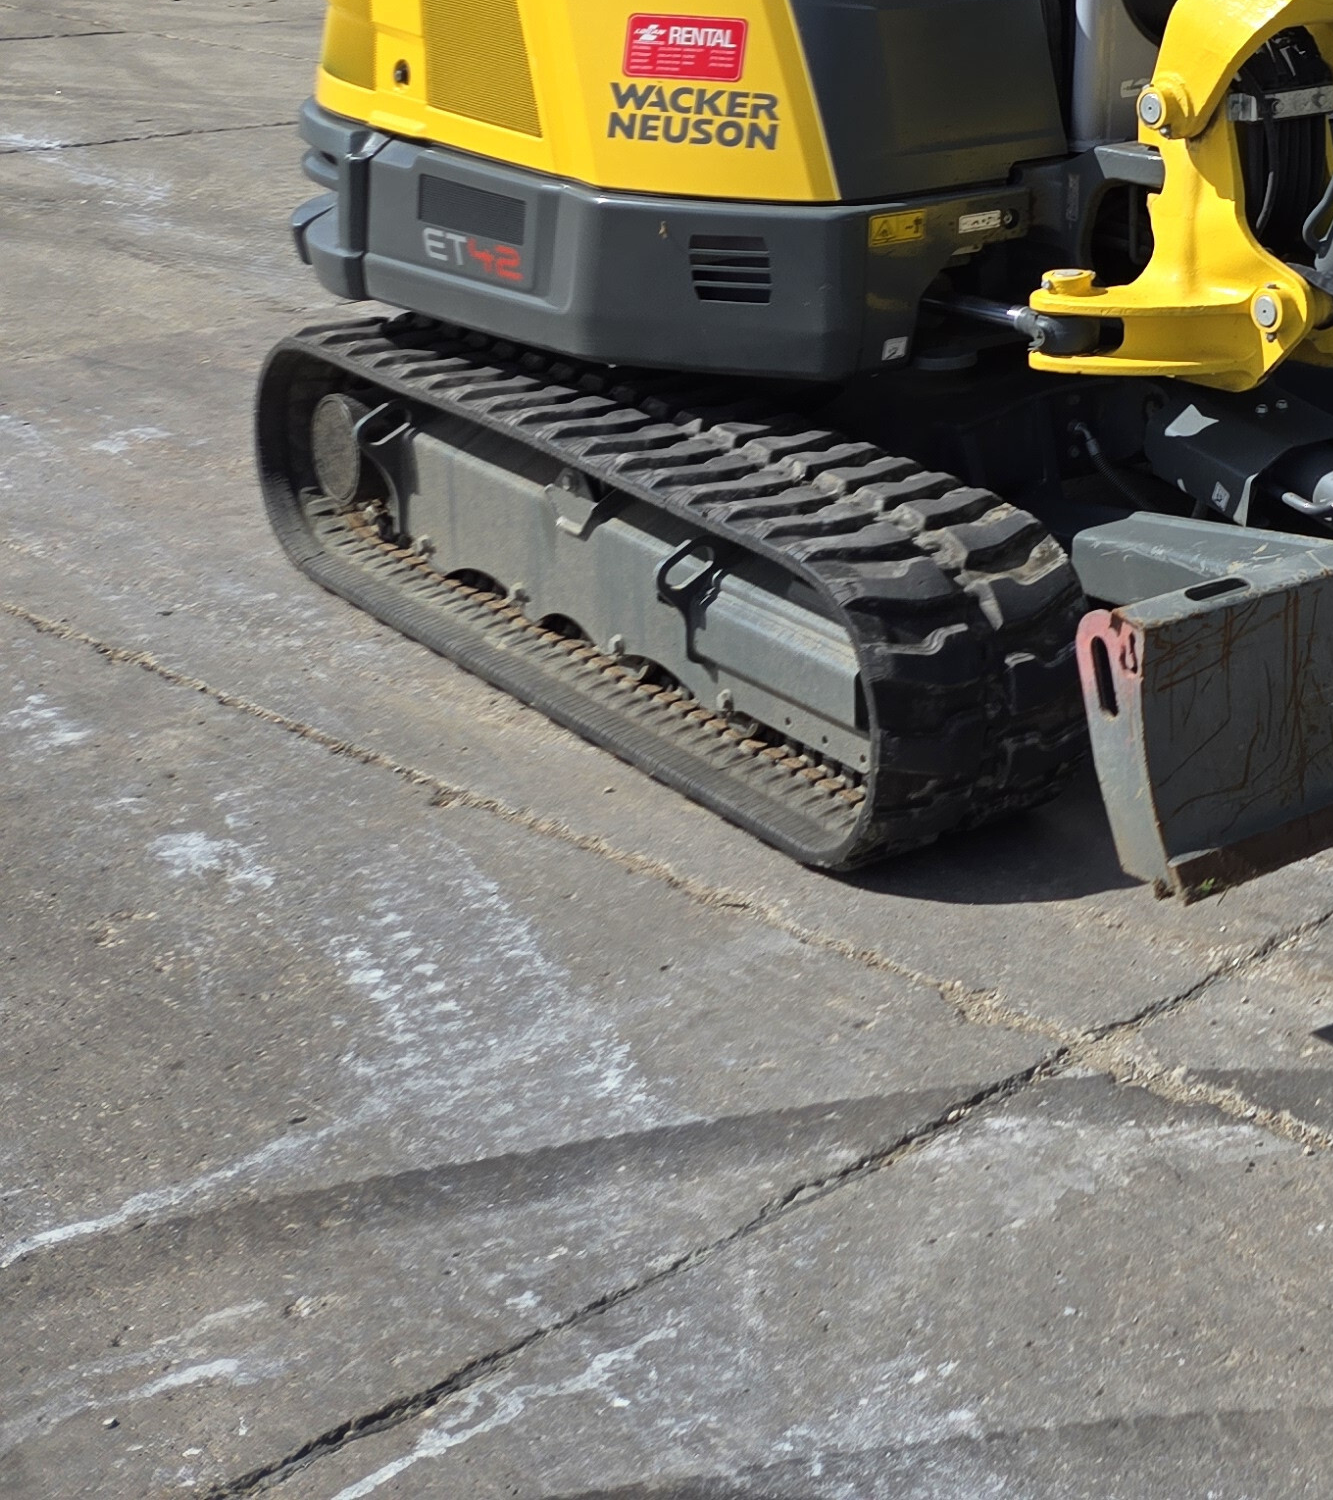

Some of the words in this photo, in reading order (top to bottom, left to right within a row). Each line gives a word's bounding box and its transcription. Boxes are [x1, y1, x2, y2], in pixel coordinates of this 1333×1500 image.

[668, 26, 737, 48] RENTAL
[610, 82, 778, 121] WACKER
[607, 112, 778, 150] NEUSON
[423, 227, 524, 282] ET42
